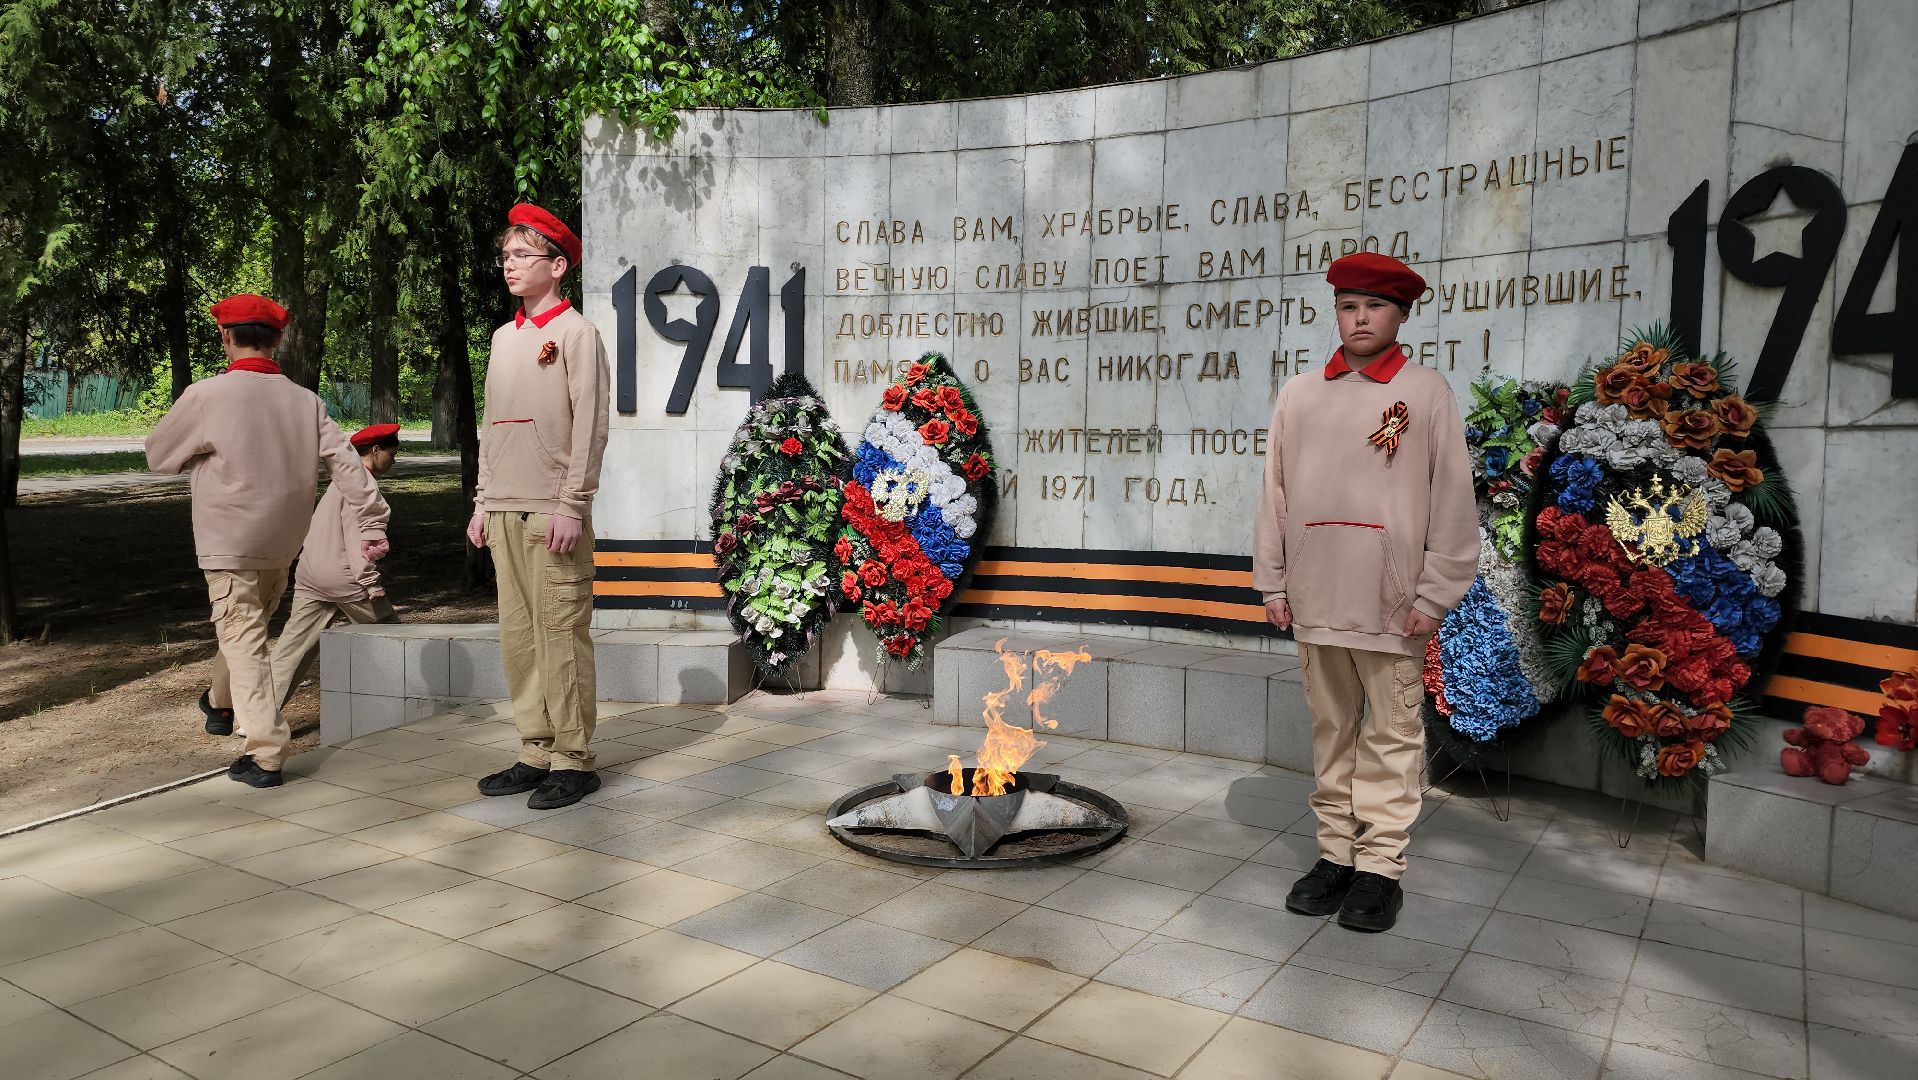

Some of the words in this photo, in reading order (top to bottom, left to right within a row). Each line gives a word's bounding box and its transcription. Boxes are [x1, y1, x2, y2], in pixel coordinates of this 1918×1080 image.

[836, 219, 925, 246] СЛАВА
[954, 215, 1019, 245] ВАМ,
[1042, 204, 1190, 240] ХРАБРЫЕ,
[1210, 189, 1319, 227] СЛАВА,
[1343, 135, 1628, 212] БЕССТРАШНЫЕ
[836, 265, 949, 292] ВЕЧНУЮ
[975, 260, 1067, 290] СЛАВУ
[1094, 255, 1171, 285] ПОЕТ
[1198, 247, 1266, 280] ВАМ
[835, 312, 1004, 340] ДОБЛЕСТНО
[1031, 304, 1166, 337] ЖИВШИЕ,
[1185, 296, 1317, 330] СМЕРТЬ
[1415, 264, 1642, 317] РУШИВШИЕ,
[612, 264, 806, 415] 1941
[974, 359, 990, 384] О
[1019, 357, 1071, 384] ВАС
[1097, 350, 1240, 384] НИКОГДА
[1271, 348, 1310, 377] НЕ
[1024, 425, 1163, 455] ЖИТЕЛЕЙ
[1190, 428, 1267, 456] ПОСЕ
[1041, 475, 1095, 501] 1971
